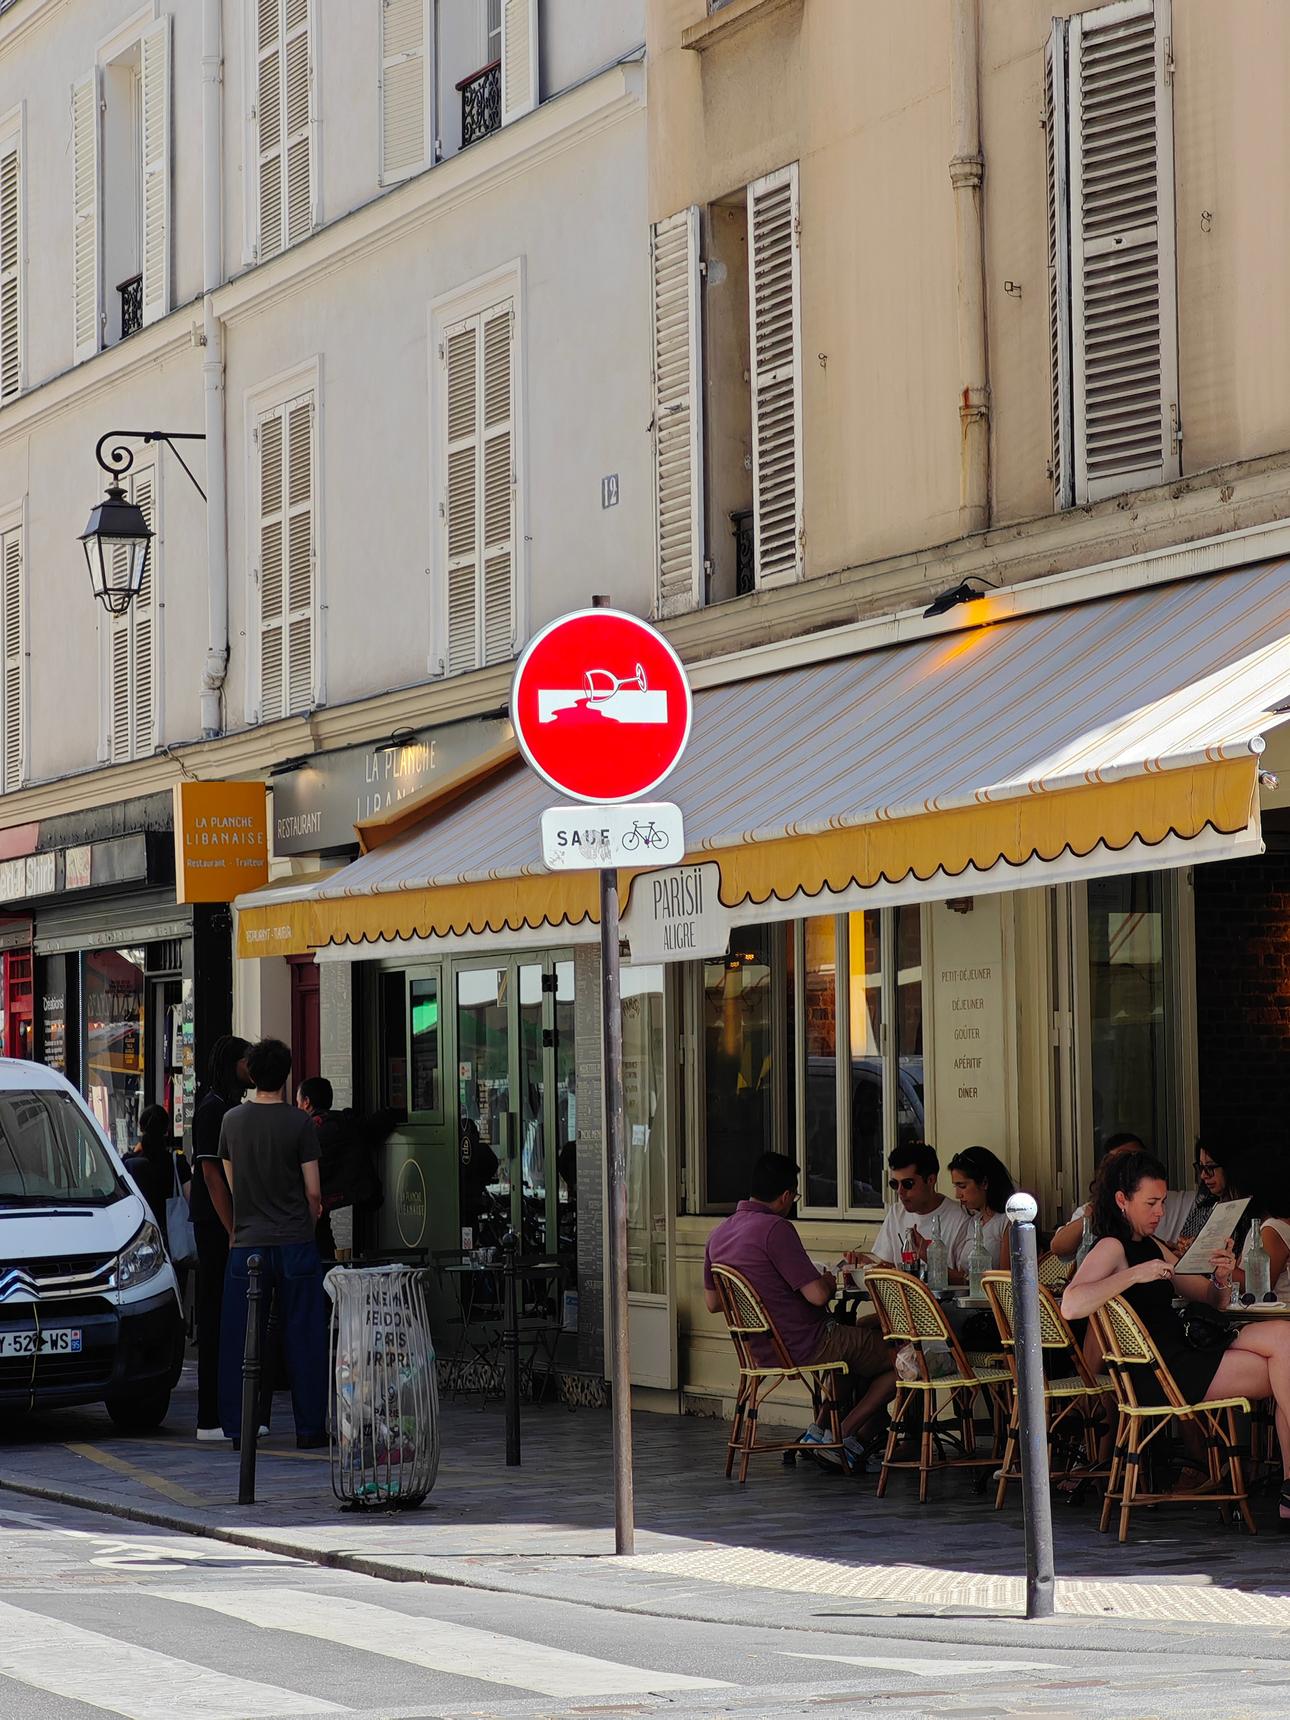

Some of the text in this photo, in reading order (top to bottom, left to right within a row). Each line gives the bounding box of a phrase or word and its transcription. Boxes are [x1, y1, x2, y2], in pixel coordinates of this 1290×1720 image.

[366, 740, 437, 783] LA PLANCHE
[195, 817, 253, 828] LA PLANCHE
[277, 811, 322, 839] RESTAURANT
[186, 832, 264, 846] LIBANAISE
[557, 829, 610, 847] SAUF
[187, 859, 226, 868] Restaurant
[236, 857, 264, 867] Traiteur
[663, 921, 697, 950] ALIGRE
[941, 967, 992, 983] PETIT-DÉJEUNER
[951, 998, 984, 1011] DÉJEUNER
[953, 1054, 983, 1069] APÉRITIF
